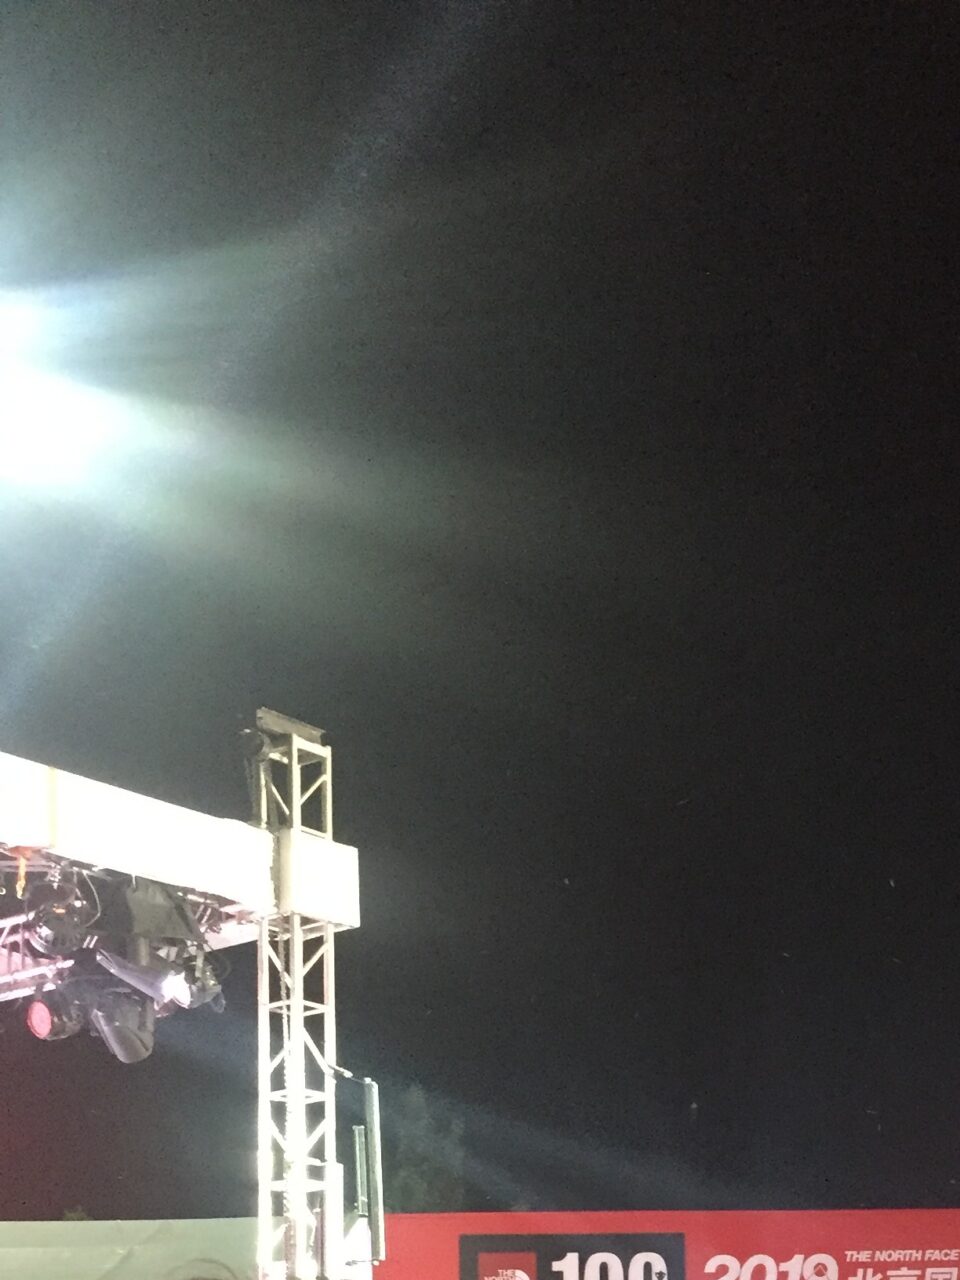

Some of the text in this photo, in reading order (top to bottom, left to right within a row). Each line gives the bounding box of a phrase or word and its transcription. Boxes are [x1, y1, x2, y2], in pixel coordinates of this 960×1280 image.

[845, 1250, 872, 1262] THE
[874, 1250, 922, 1262] NORTH
[924, 1249, 960, 1261] FACE
[497, 1269, 515, 1277] THE
